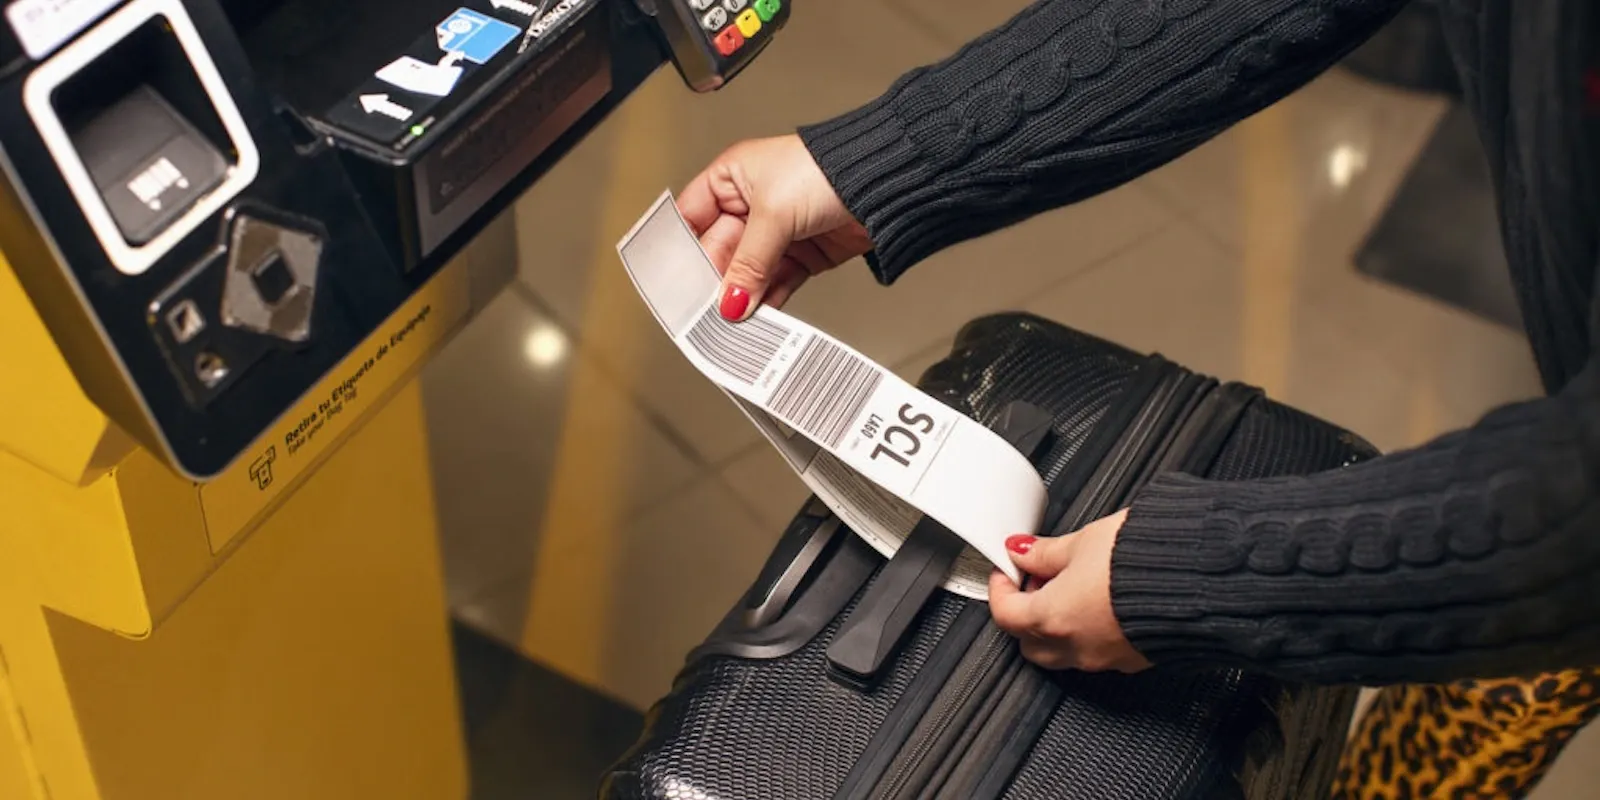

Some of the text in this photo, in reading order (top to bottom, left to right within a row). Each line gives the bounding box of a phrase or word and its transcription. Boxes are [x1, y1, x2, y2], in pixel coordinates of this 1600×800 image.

[285, 304, 431, 446] Retira tu Etiqueta de Equipaje
[870, 402, 935, 468] SCL
